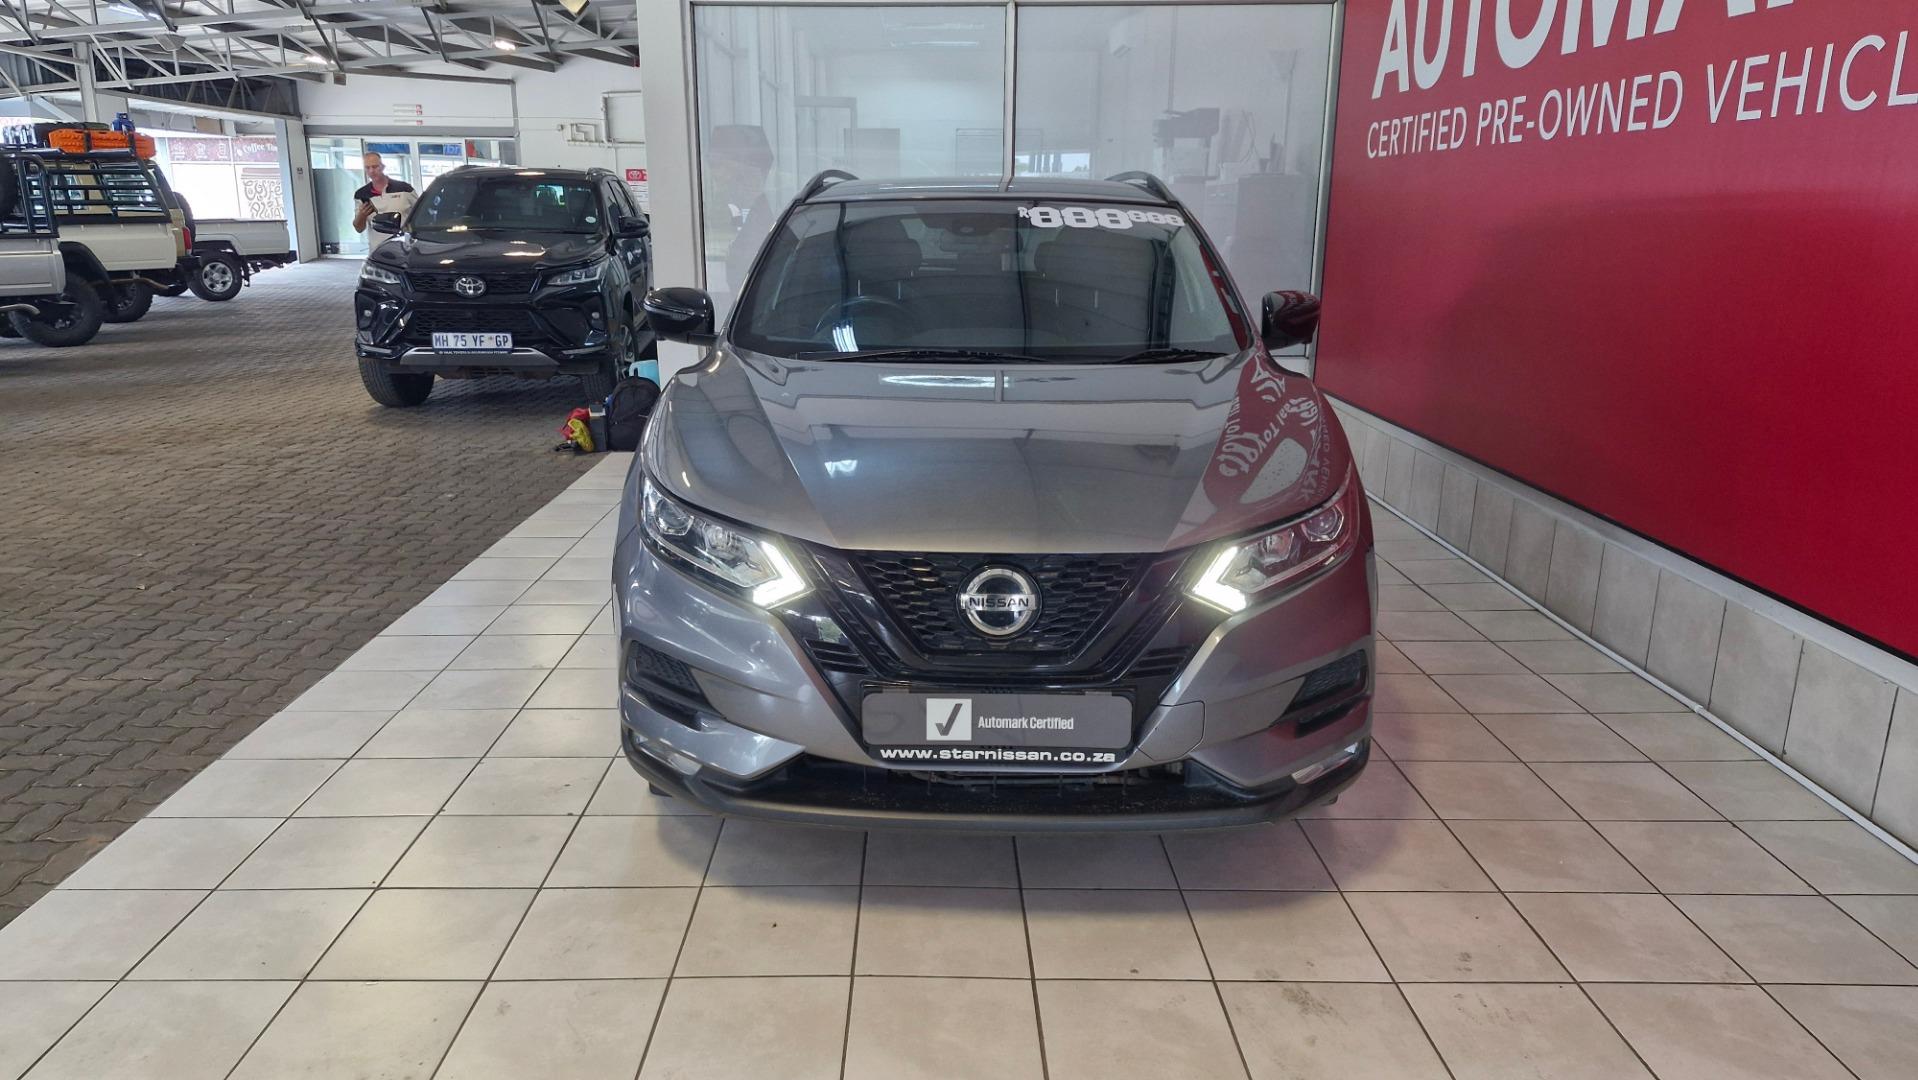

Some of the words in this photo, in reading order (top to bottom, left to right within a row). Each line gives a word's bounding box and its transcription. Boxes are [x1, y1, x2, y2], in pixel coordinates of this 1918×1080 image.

[1367, 106, 1467, 158] CERTIFIED
[1476, 71, 1683, 147] PRE-OWNED
[435, 335, 449, 347] MH
[453, 335, 467, 347] 75
[472, 335, 484, 347] YF
[495, 335, 508, 347] GP
[969, 597, 1030, 608] NISSAN
[978, 716, 1029, 729] Automark
[1029, 716, 1075, 730] Certified
[880, 747, 1116, 763] www.starnissan.co.za
